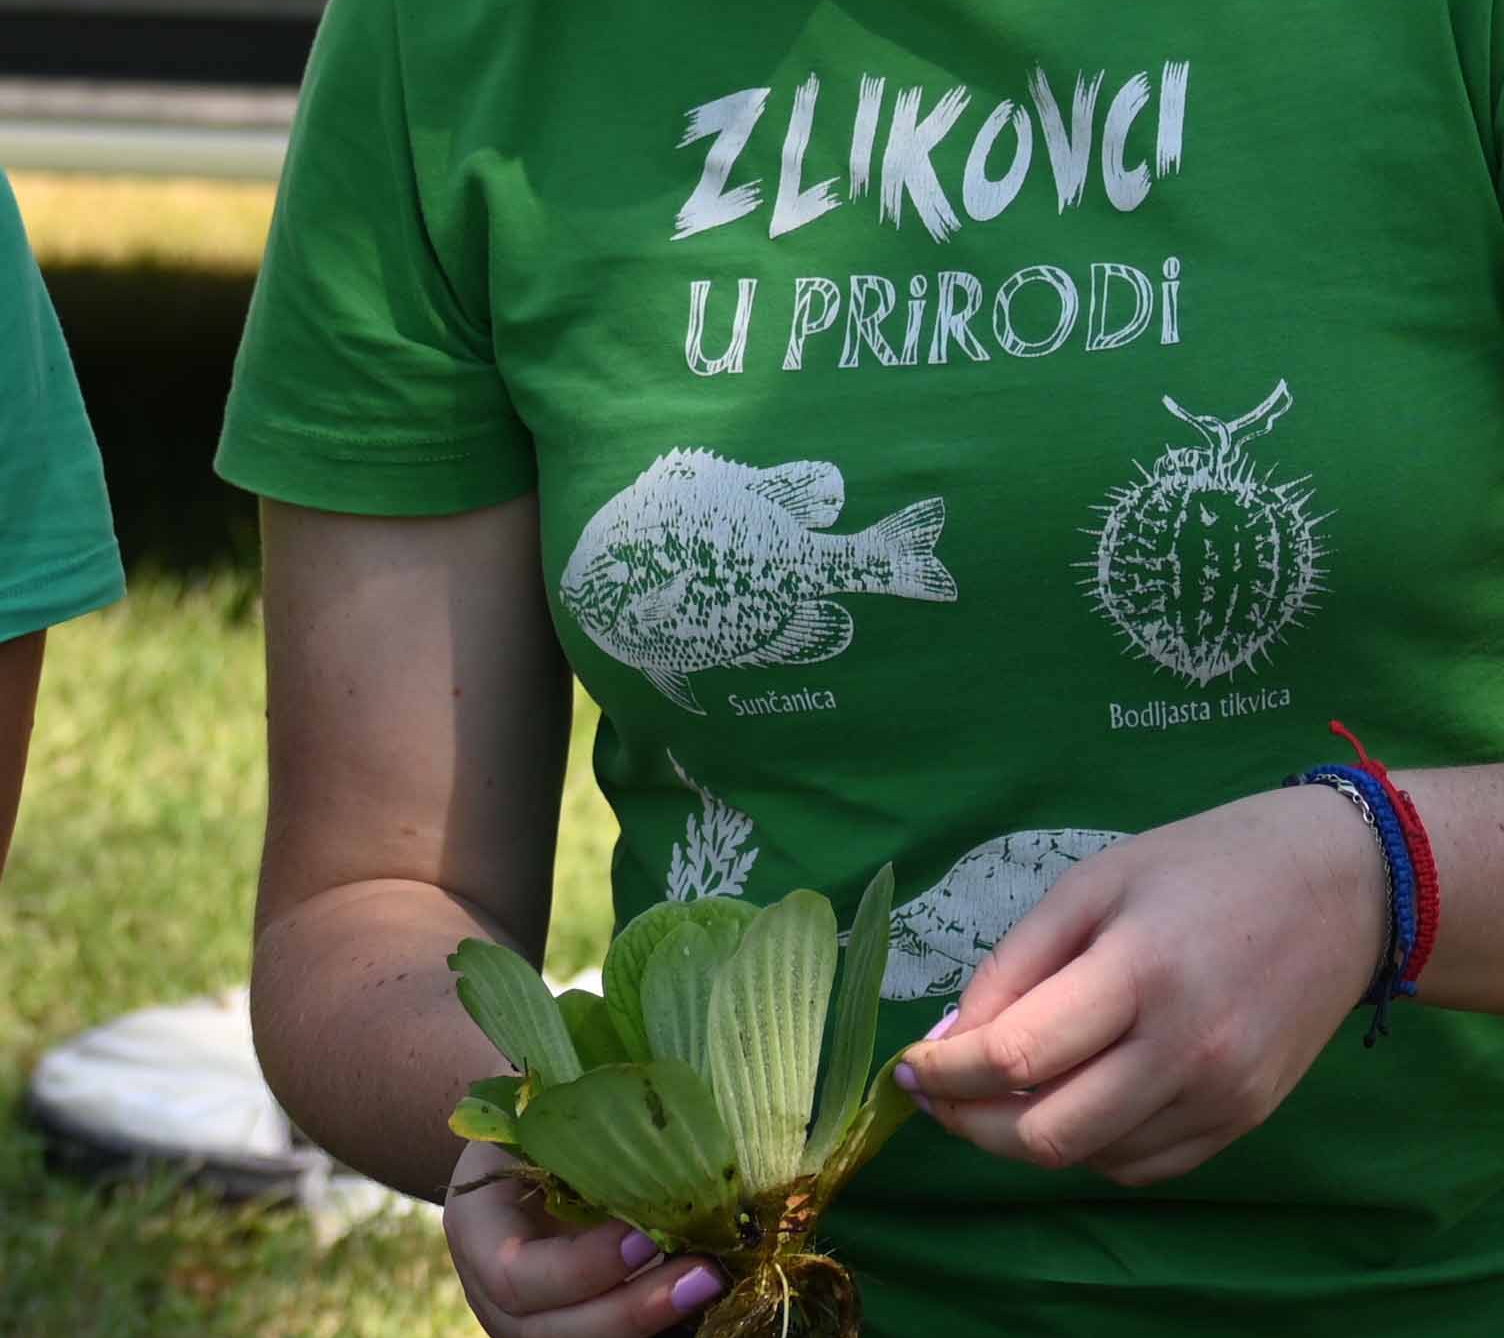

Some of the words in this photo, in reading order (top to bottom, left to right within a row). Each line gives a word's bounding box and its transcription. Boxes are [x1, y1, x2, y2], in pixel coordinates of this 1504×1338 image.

[670, 60, 1190, 244] ZLIKOVCI
[684, 277, 758, 376] U
[727, 686, 837, 717] Sunčanica
[1109, 700, 1212, 730] Bodljasta
[1220, 687, 1292, 718] tikvica
